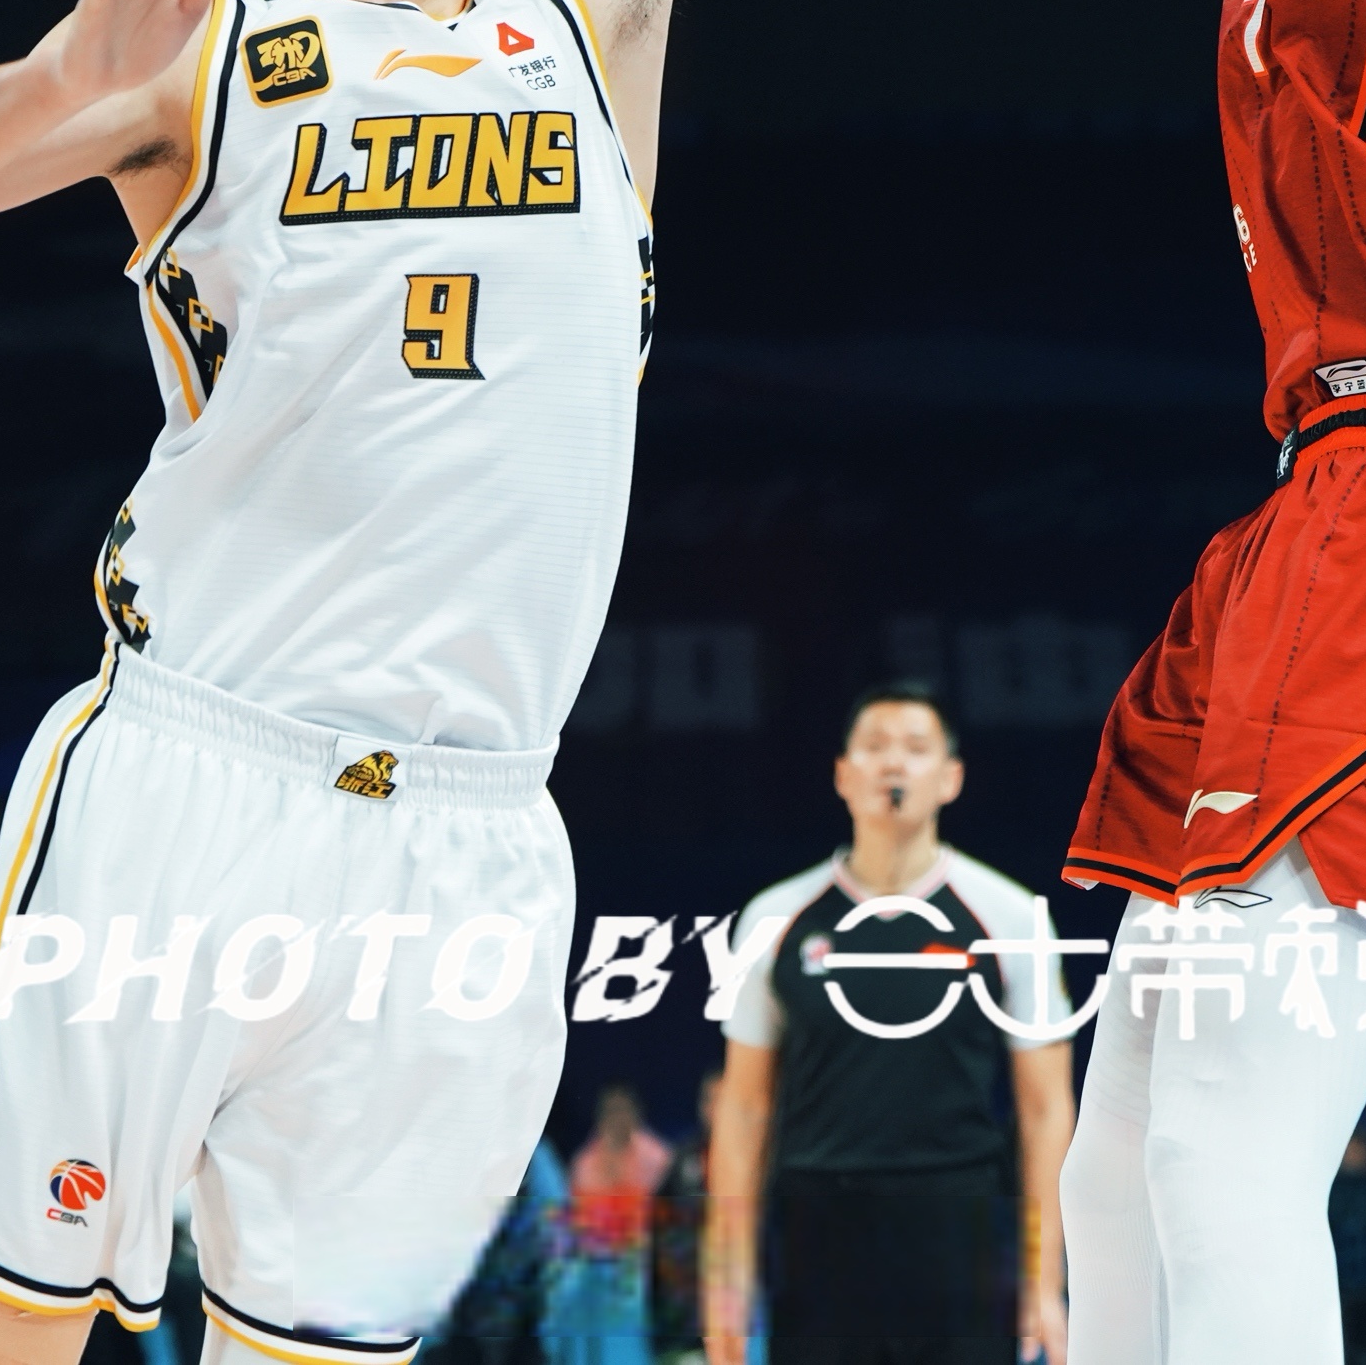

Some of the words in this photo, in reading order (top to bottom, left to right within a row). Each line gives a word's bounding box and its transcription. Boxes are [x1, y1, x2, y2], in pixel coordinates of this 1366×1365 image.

[272, 67, 317, 87] CBA
[507, 55, 557, 78] 广发银行
[526, 74, 557, 91] CGB
[278, 110, 581, 227] LIONS
[401, 273, 487, 381] 9
[46, 1207, 89, 1228] CBA
